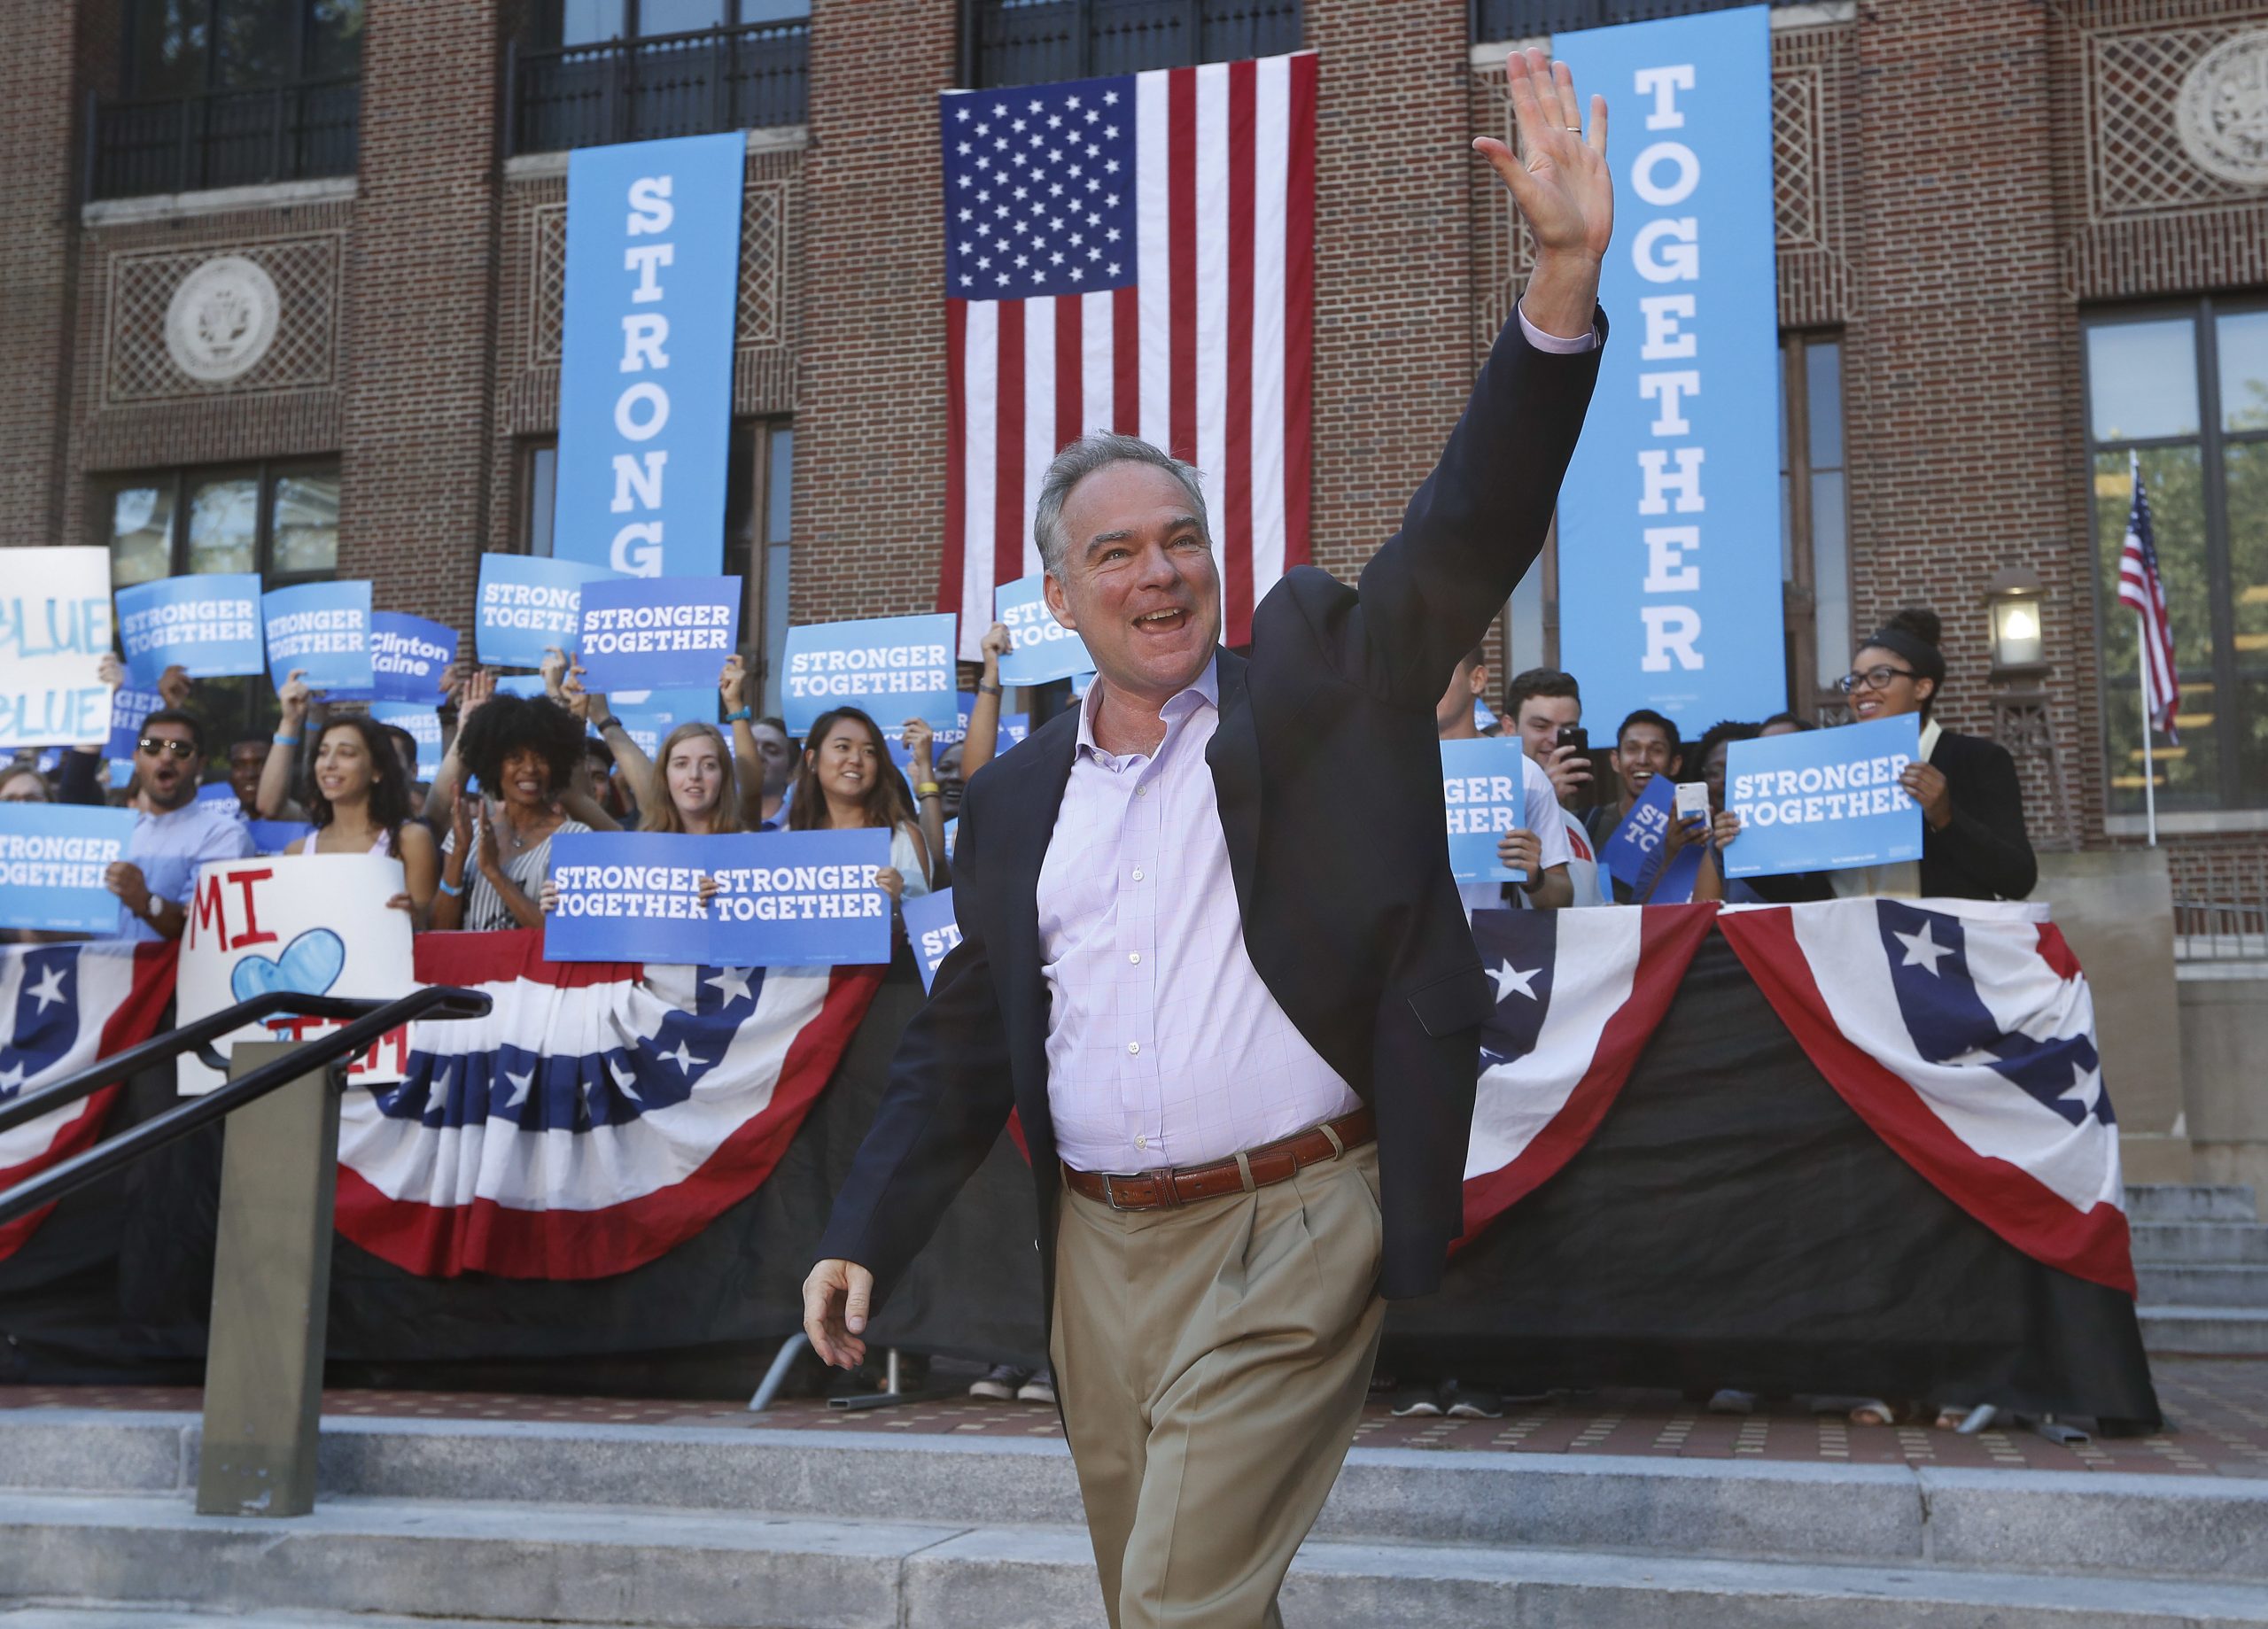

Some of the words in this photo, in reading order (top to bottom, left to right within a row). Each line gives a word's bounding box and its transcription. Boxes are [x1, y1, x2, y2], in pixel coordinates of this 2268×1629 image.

[610, 176, 674, 578] STRONG
[1631, 64, 1705, 671] TOGETHER
[124, 600, 254, 633] STRONGER
[268, 609, 364, 640] STRONGER
[584, 605, 730, 632] STRONGER
[127, 621, 255, 655] TOGETHER
[369, 632, 450, 663] Clinton
[582, 629, 728, 655] TOGETHER
[1009, 621, 1077, 649] TOG
[791, 645, 946, 673] STRONGER
[790, 670, 947, 697] TOGETHER
[1734, 754, 1911, 800] STRONGER
[1733, 786, 1913, 829] TOGETHER
[714, 865, 880, 894] STRONGER
[190, 868, 278, 952] MI
[555, 893, 708, 919] TOGETHER
[715, 892, 882, 922] TOGETHER
